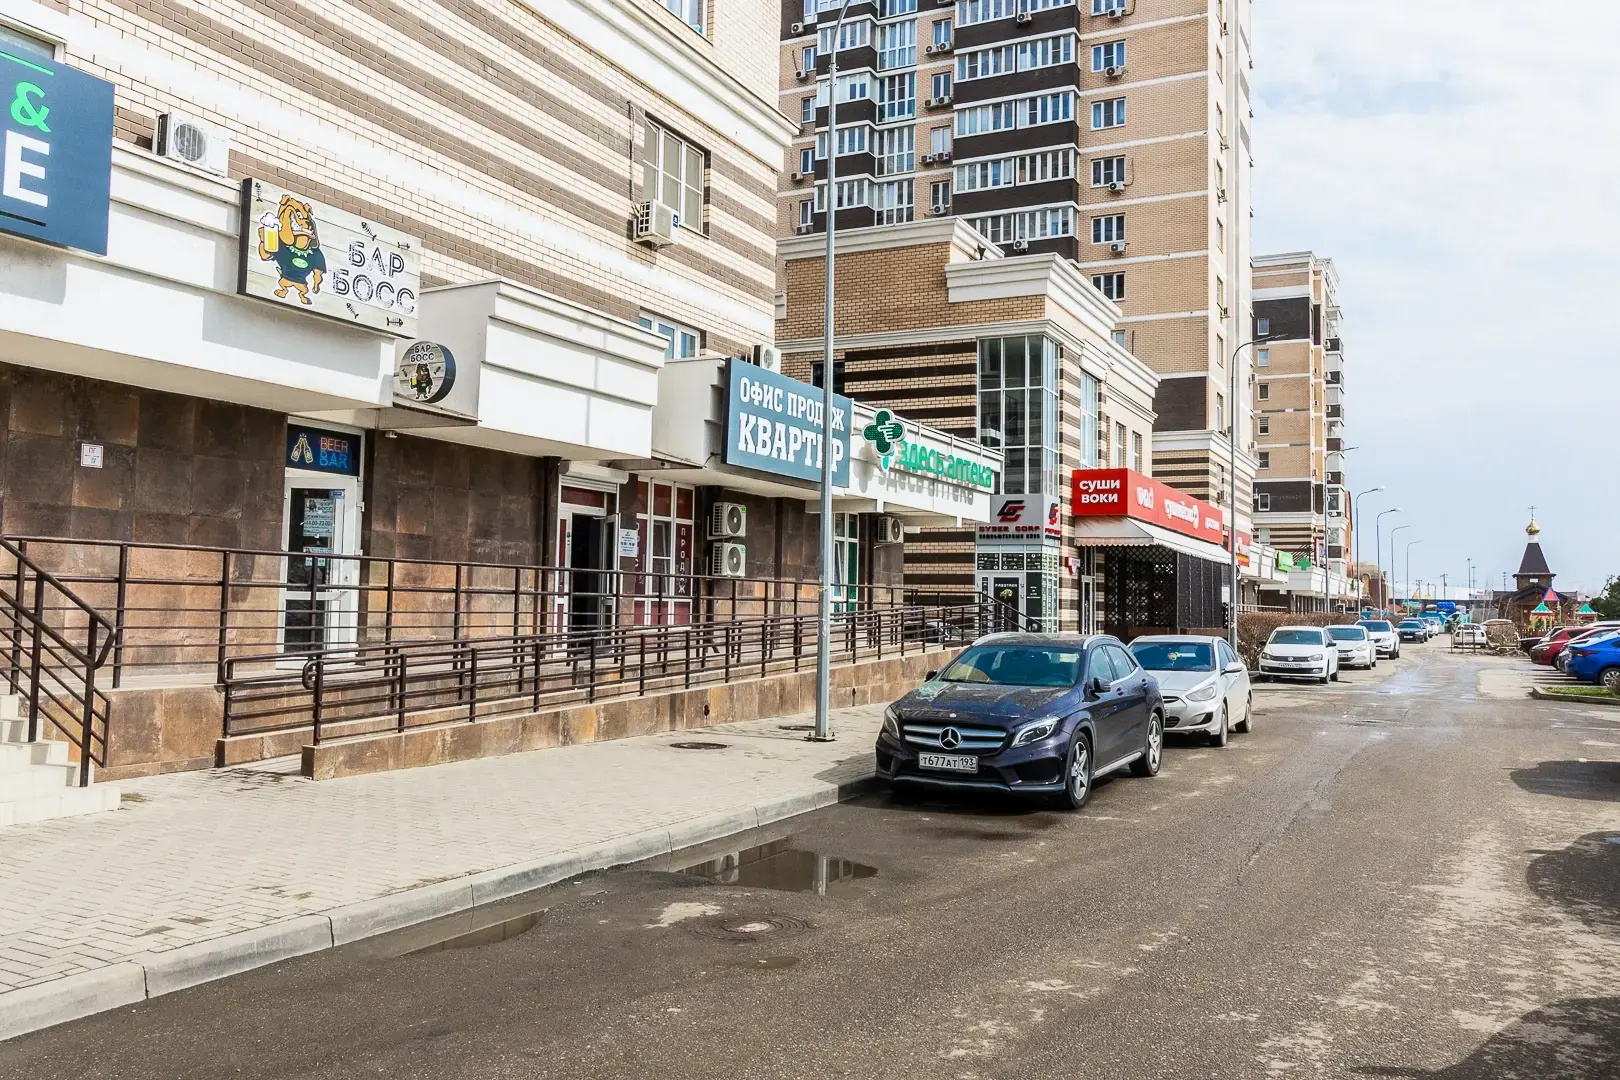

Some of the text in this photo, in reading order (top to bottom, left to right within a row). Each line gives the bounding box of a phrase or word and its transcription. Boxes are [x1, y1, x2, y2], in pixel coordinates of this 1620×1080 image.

[348, 240, 405, 278] БАР
[332, 267, 415, 315] БОСС
[410, 353, 435, 362] БОСС
[414, 344, 431, 353] БАР
[740, 376, 845, 432] ОФИС ПРОДЖ
[320, 437, 349, 454] BEER
[319, 451, 348, 469] BAR
[947, 454, 993, 488] аптека
[959, 757, 974, 767] 193
